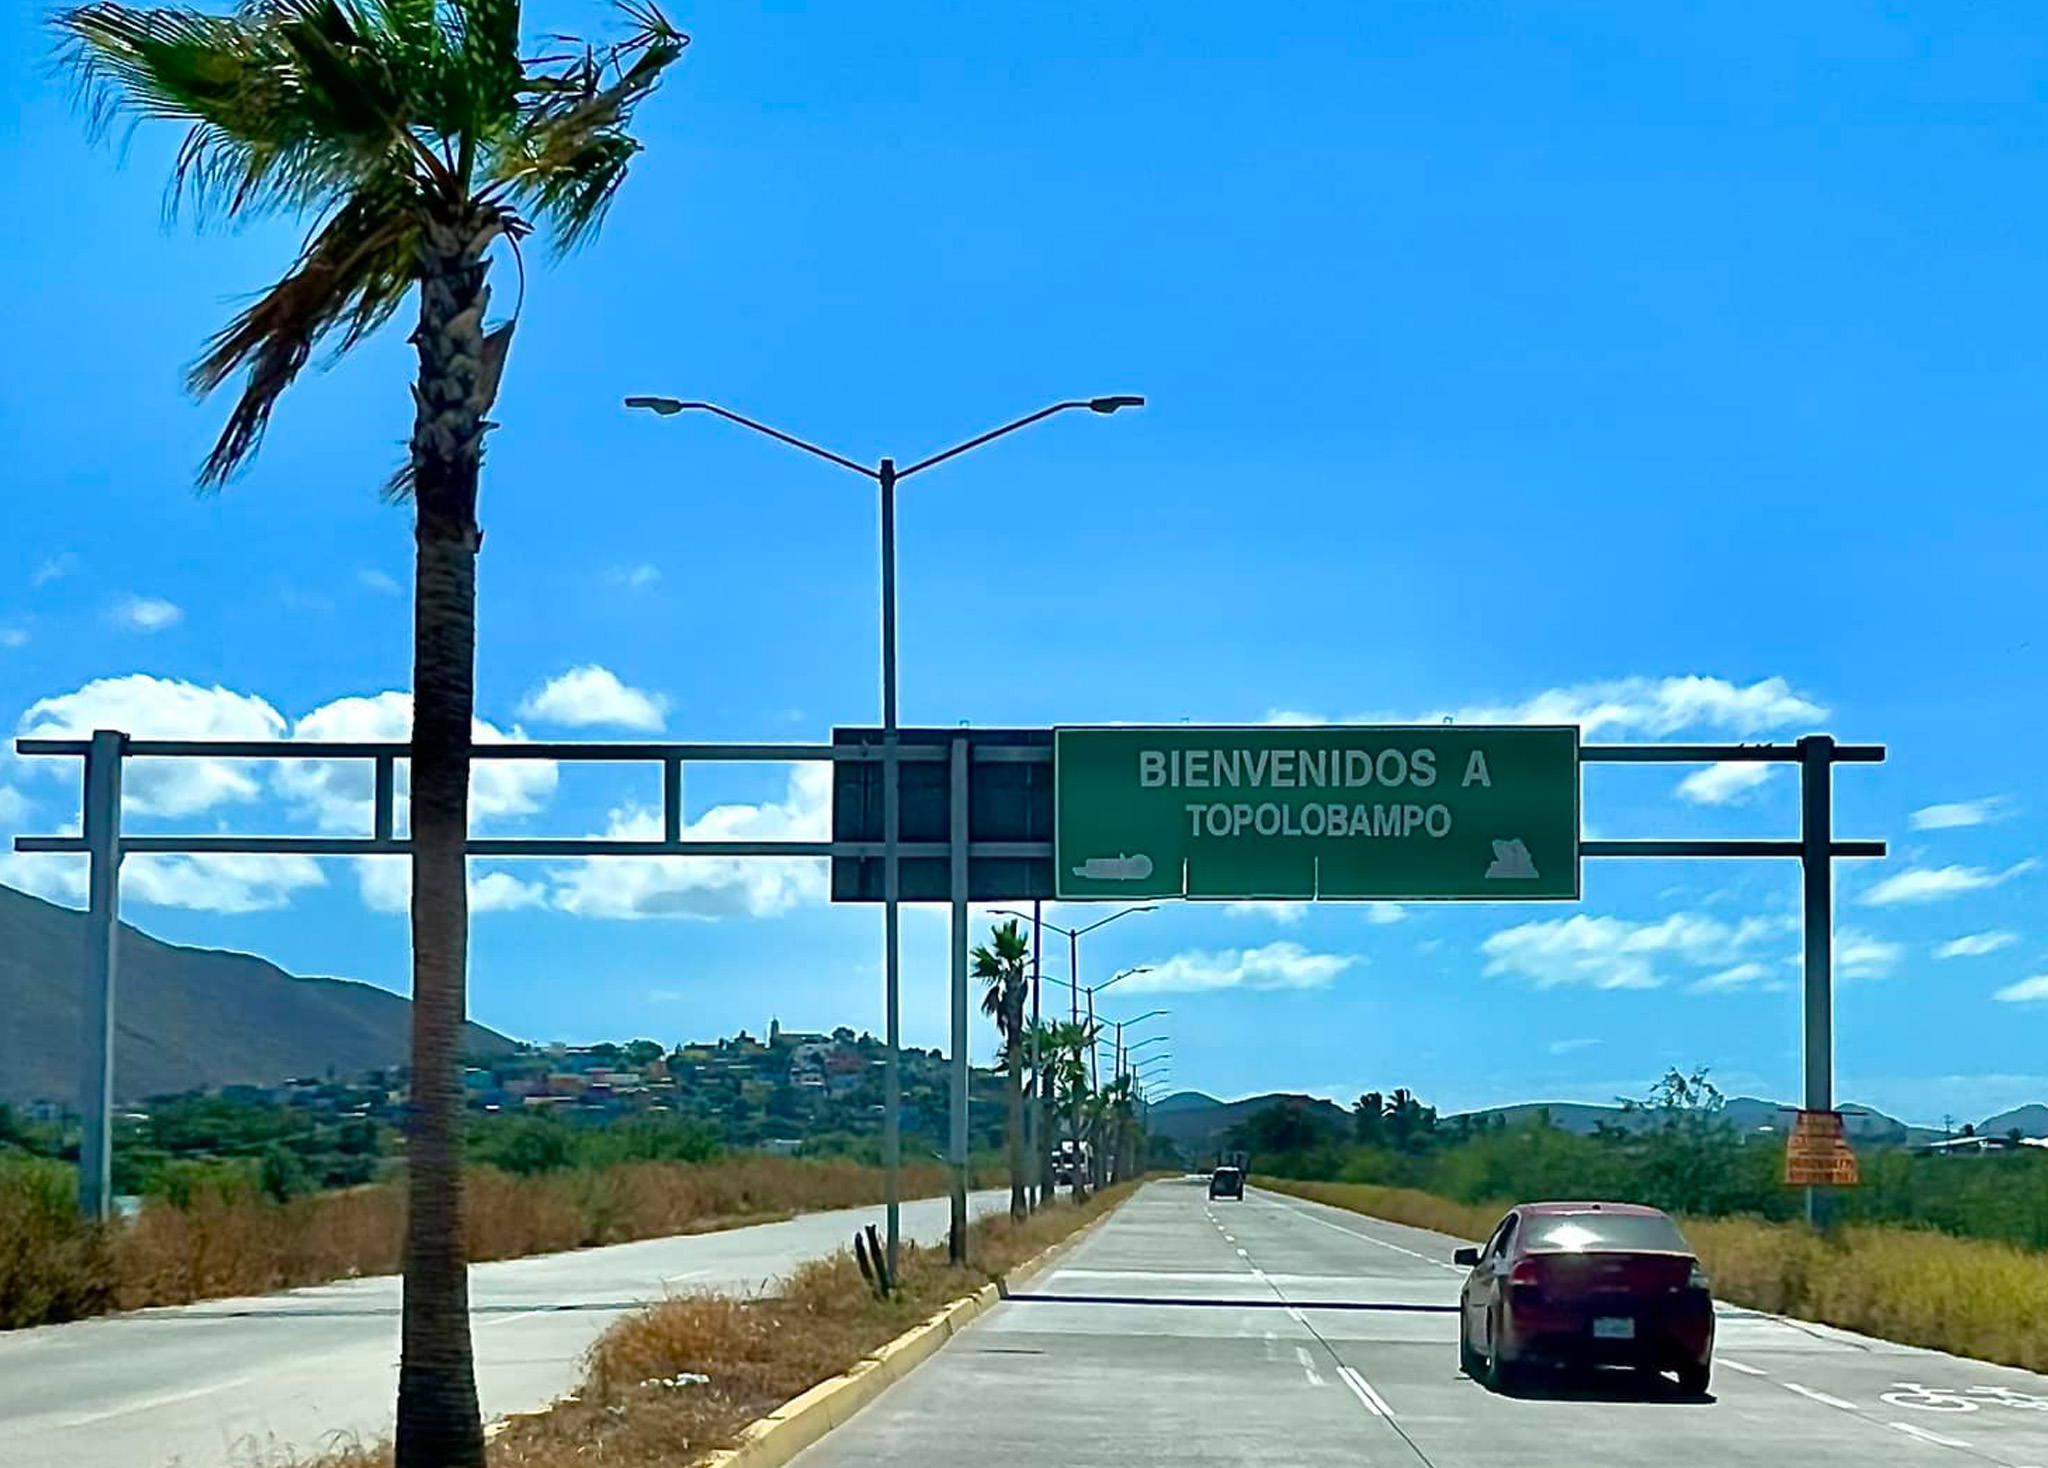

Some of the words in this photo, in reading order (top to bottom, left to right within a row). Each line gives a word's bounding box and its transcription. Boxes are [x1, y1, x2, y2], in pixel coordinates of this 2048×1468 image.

[1139, 749, 1437, 788] BIENVENIDOS
[1462, 750, 1492, 788] A
[1186, 803, 1452, 838] TOPOLOBAMPO
